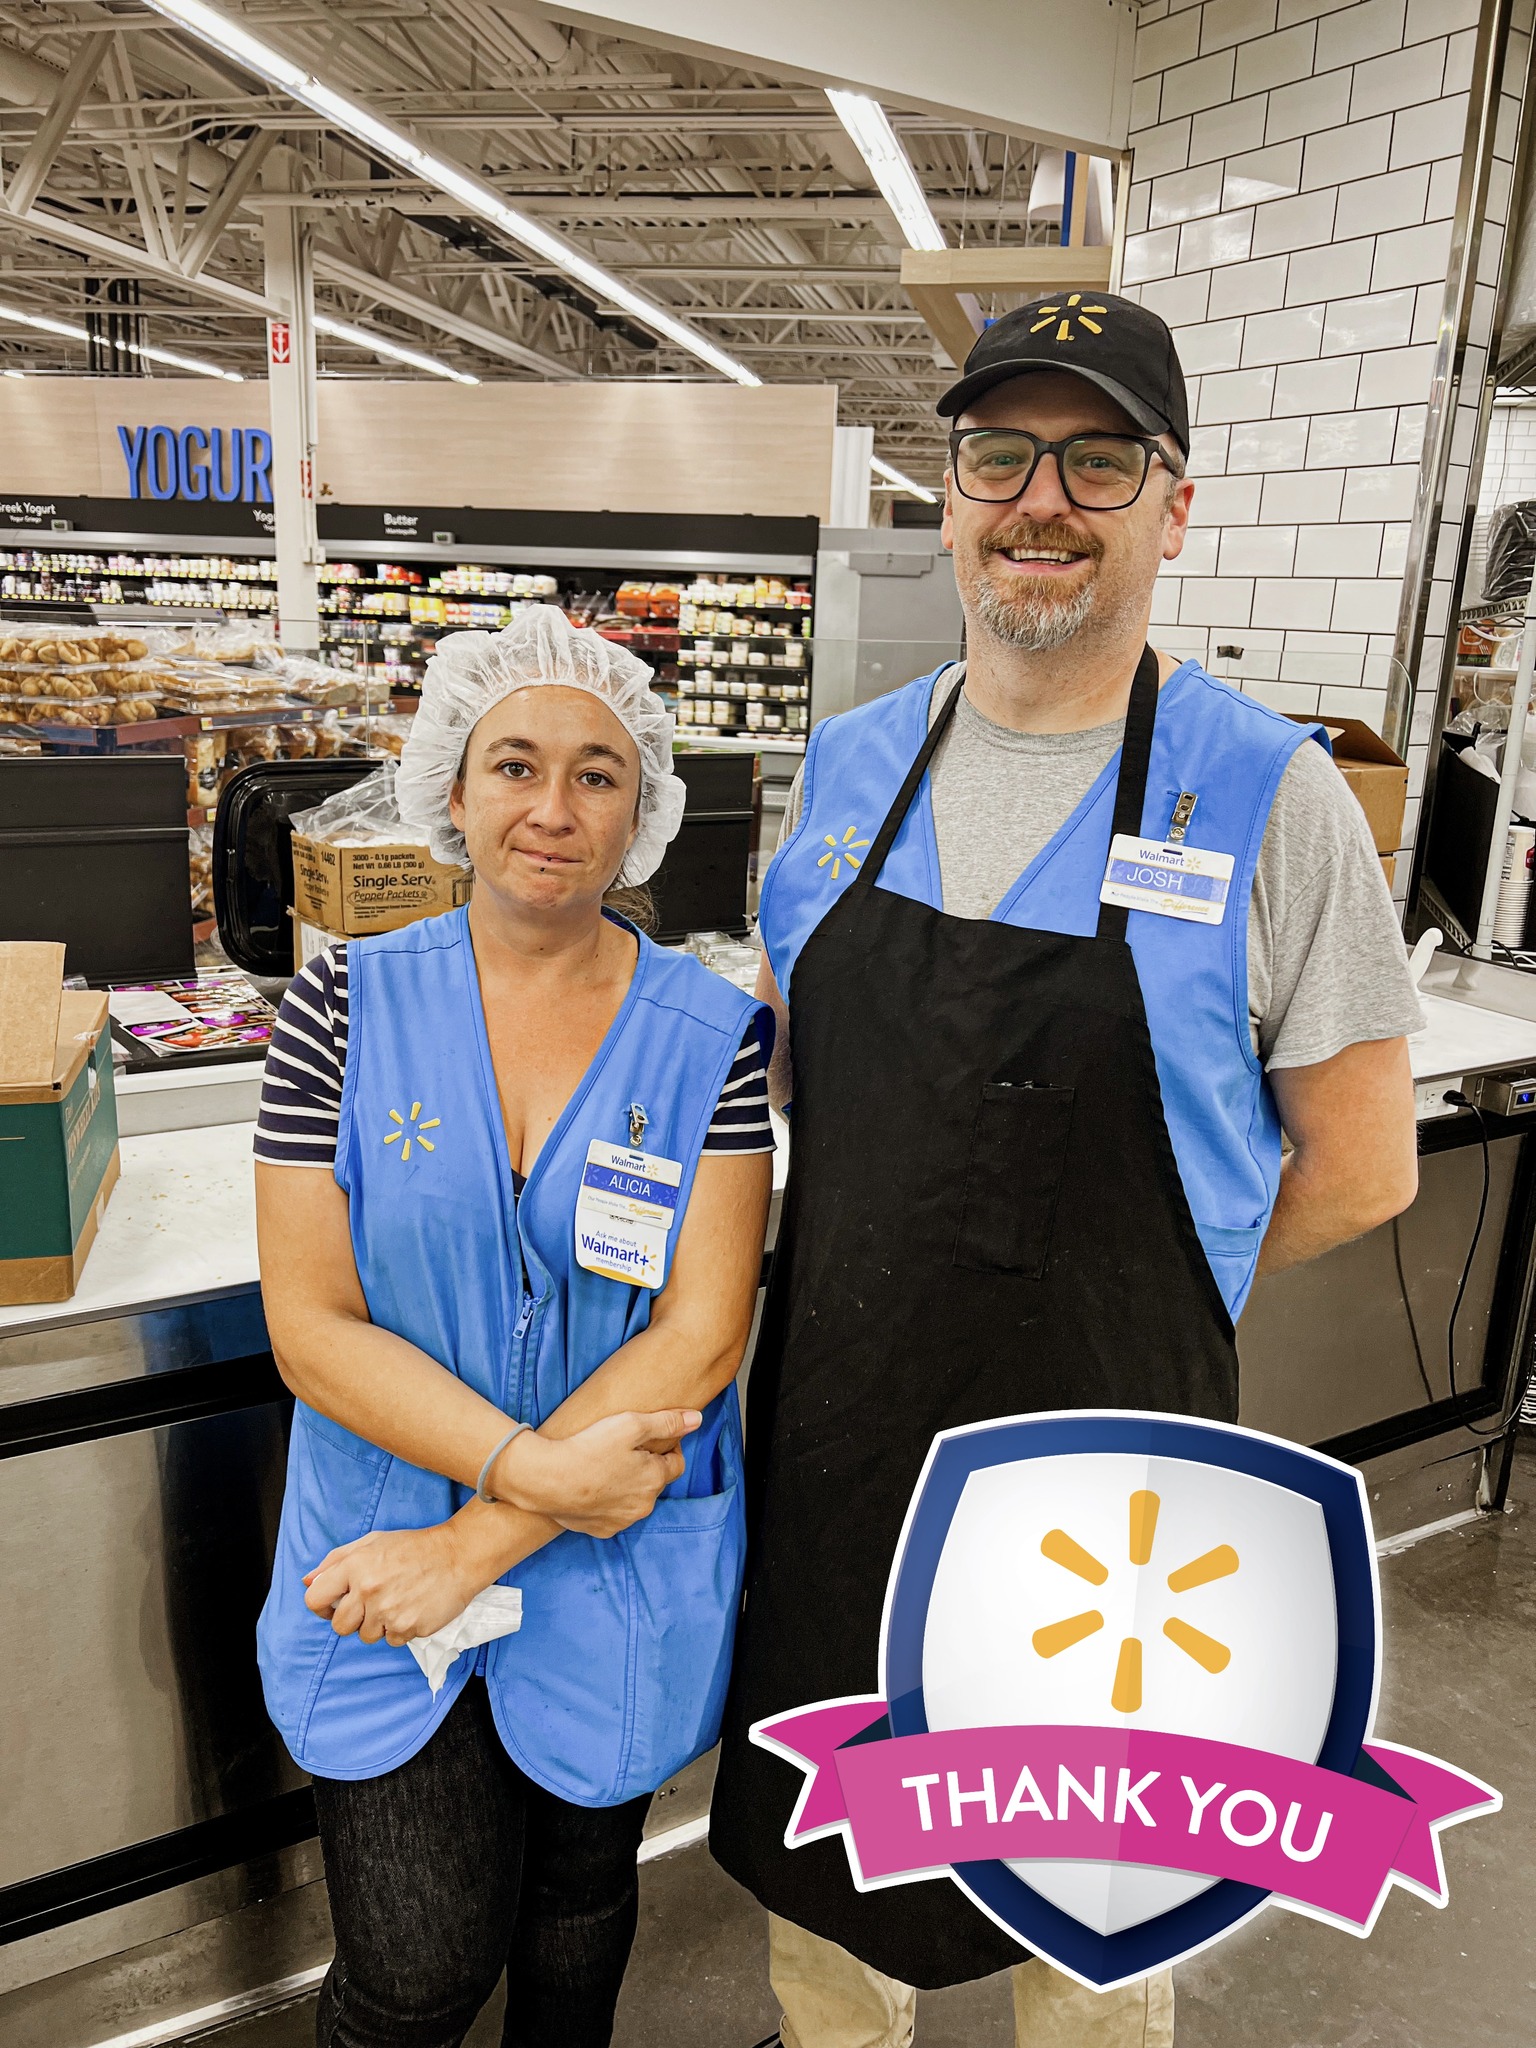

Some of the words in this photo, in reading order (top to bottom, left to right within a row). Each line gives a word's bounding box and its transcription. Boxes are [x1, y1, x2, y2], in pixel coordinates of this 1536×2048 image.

[0, 502, 22, 514] reek
[23, 502, 56, 516] Yogurt
[384, 512, 418, 526] Butter
[375, 853, 389, 862] 0.1g
[390, 853, 415, 861] packets
[1139, 849, 1184, 866] Walmart
[353, 874, 398, 890] Single
[1126, 866, 1183, 891] JOSH
[354, 891, 385, 903] Pepper
[387, 889, 420, 900] Packets
[611, 1155, 646, 1173] Walmart
[608, 1174, 651, 1197] ALICIA
[595, 1230, 607, 1239] Ask
[608, 1234, 618, 1242] me
[619, 1237, 637, 1248] about
[595, 1256, 632, 1272] membership
